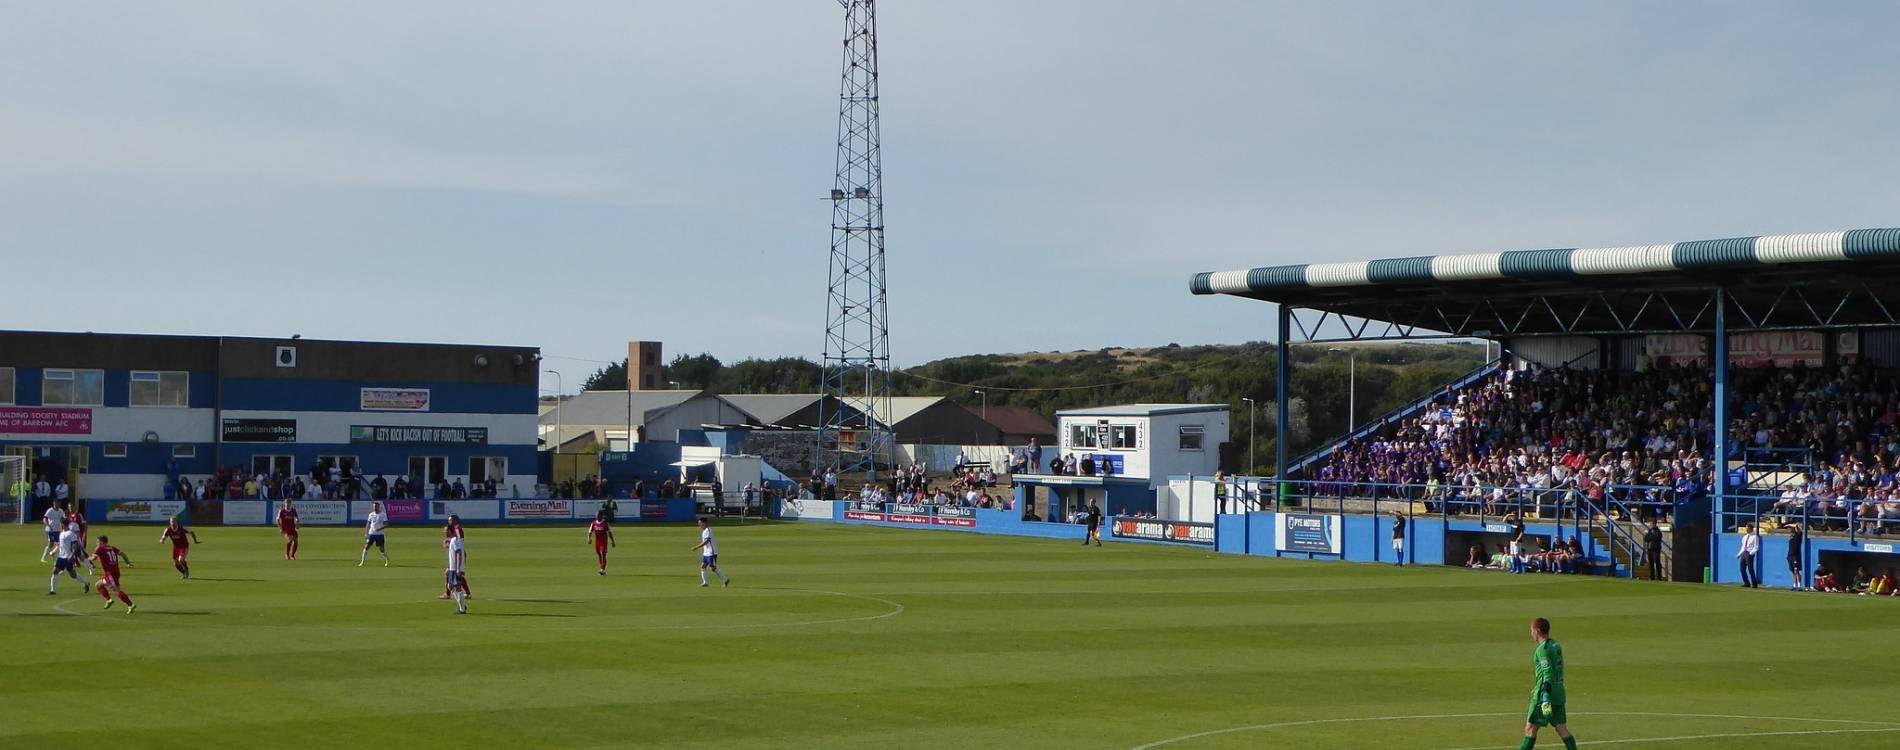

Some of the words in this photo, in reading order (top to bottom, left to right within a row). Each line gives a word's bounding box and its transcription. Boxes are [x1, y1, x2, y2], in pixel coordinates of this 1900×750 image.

[32, 412, 58, 420] SOCIETY
[377, 428, 389, 440] LET'S
[391, 428, 402, 441] KICK
[403, 429, 421, 441] RACISM
[422, 429, 433, 441] OUT
[433, 429, 441, 442] OF
[441, 429, 466, 442] FOOTBALL
[943, 508, 960, 517] Hornby
[1294, 518, 1303, 527] PYE
[1122, 520, 1163, 536] vanarama
